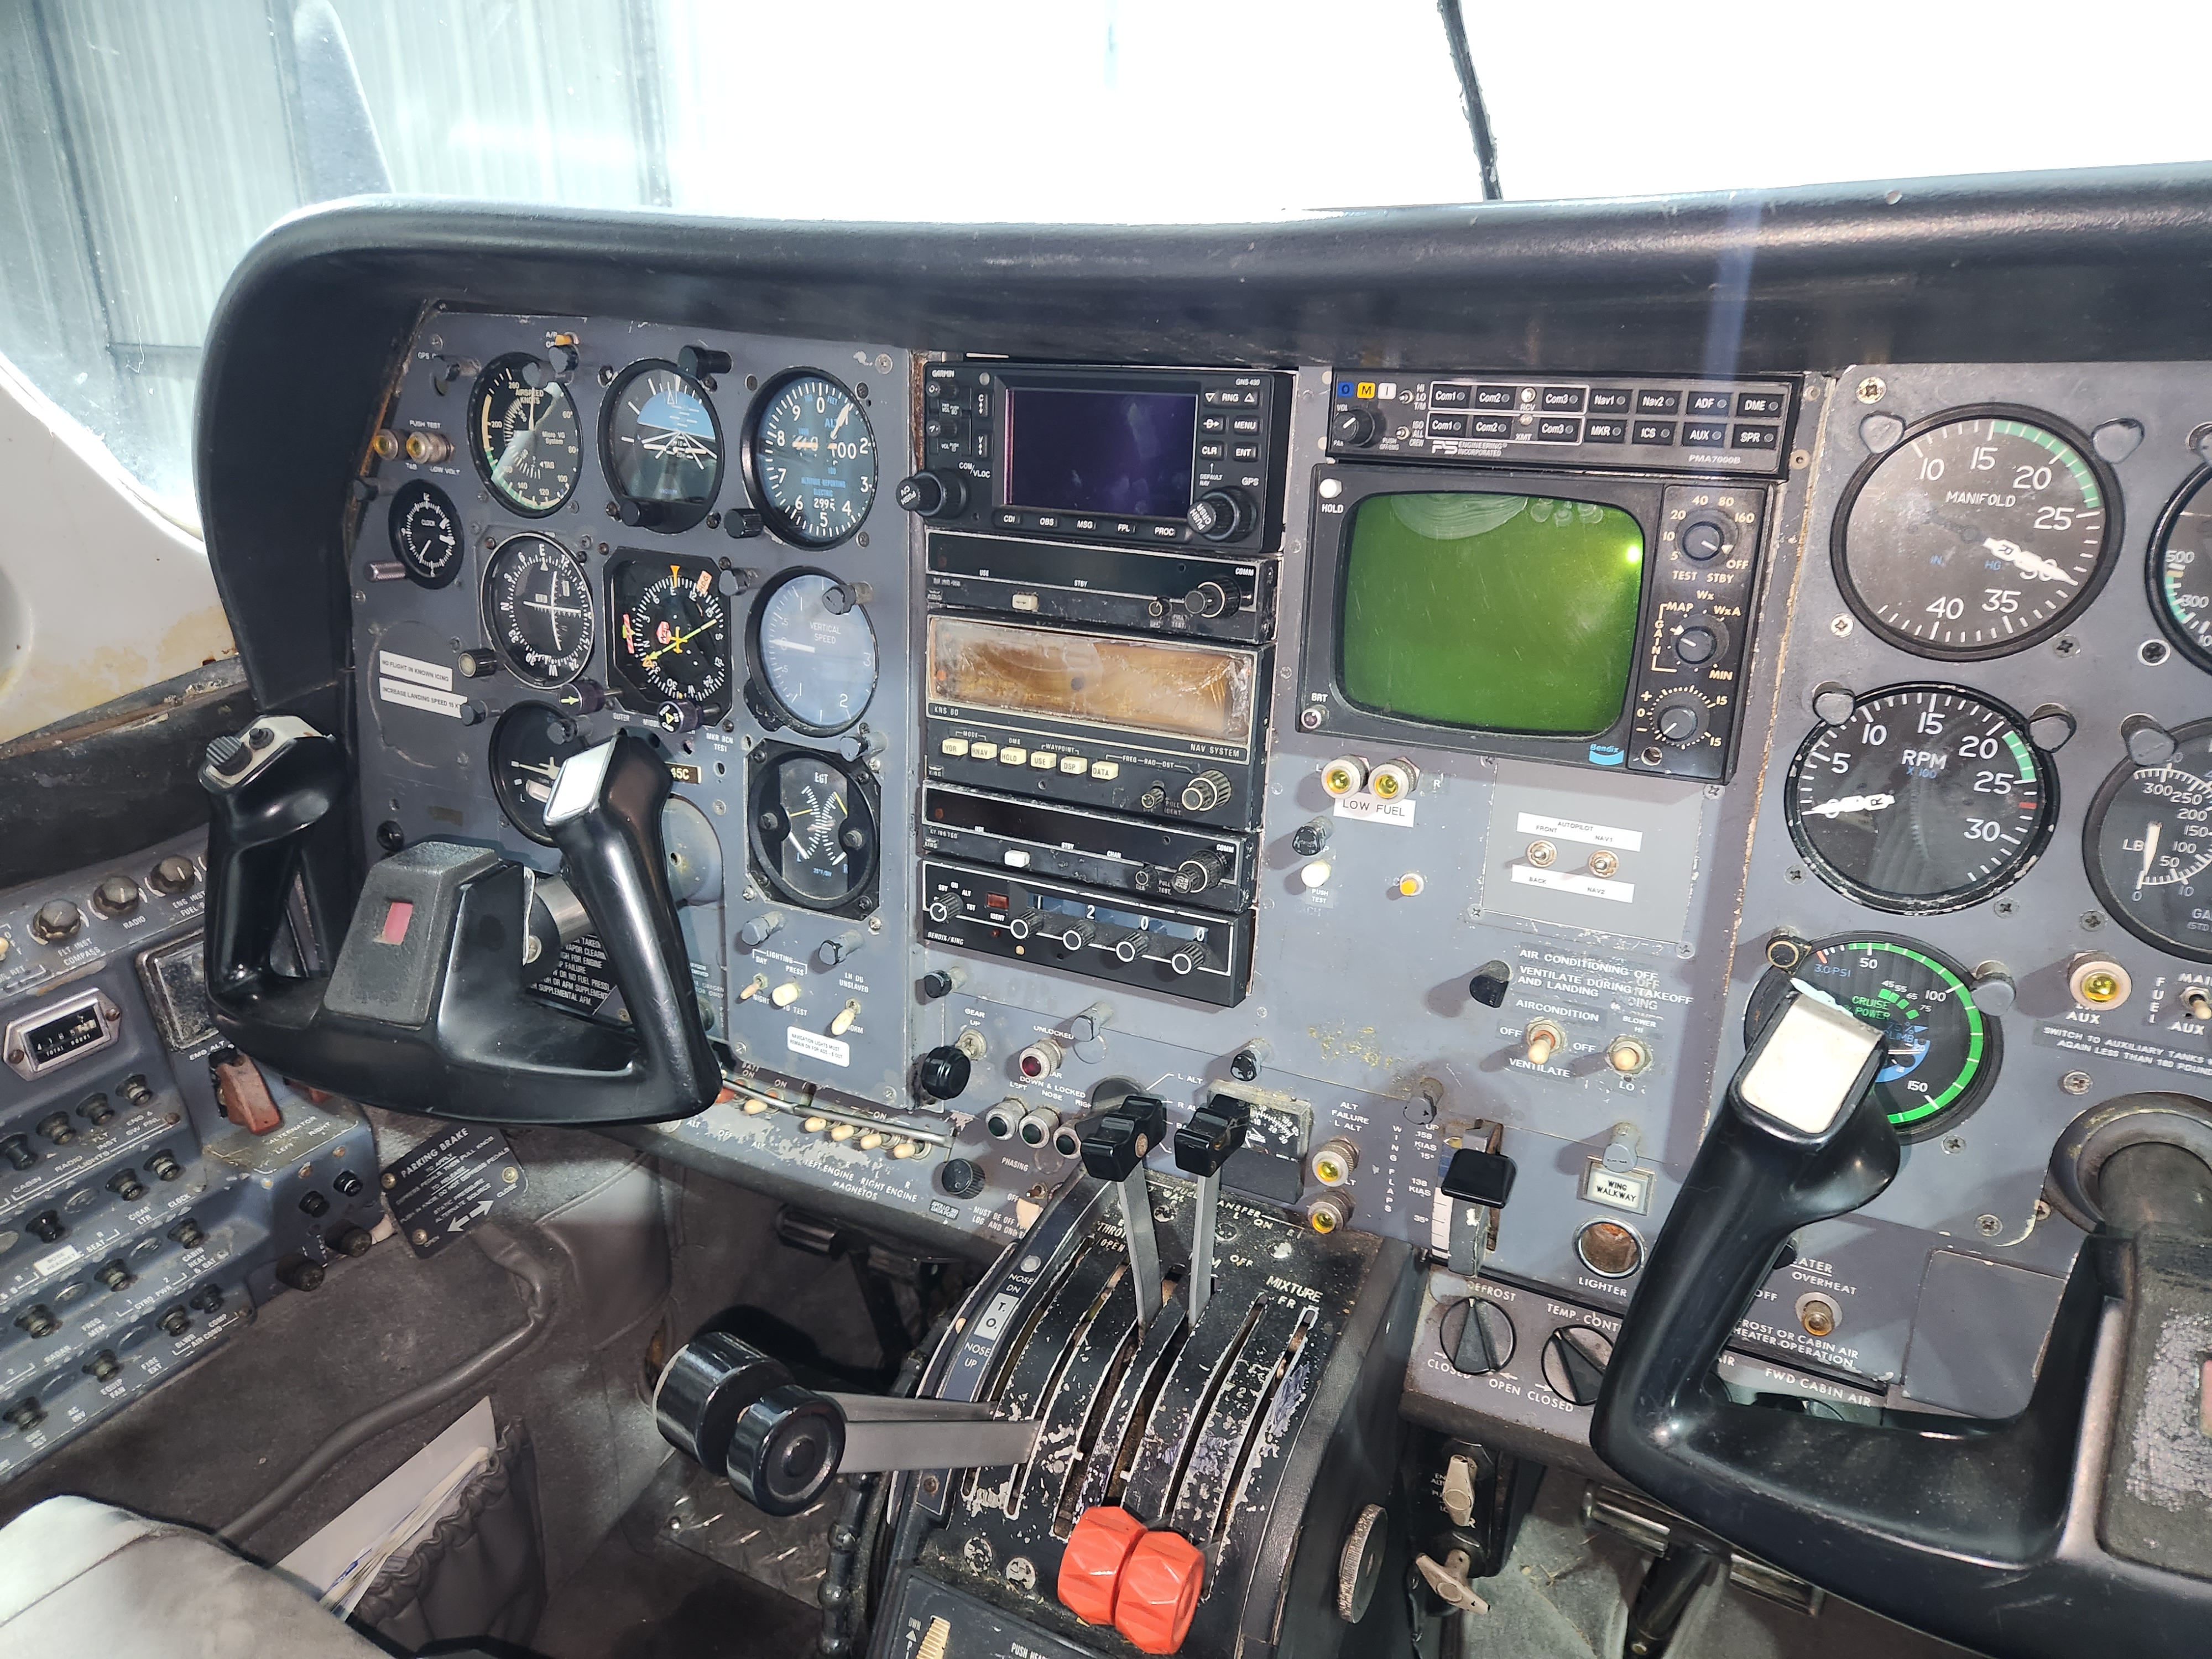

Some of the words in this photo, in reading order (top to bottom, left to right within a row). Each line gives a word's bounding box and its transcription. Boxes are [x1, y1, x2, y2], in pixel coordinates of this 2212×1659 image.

[1435, 390, 1457, 401] Com1
[1479, 392, 1500, 403] Com2
[1546, 393, 1568, 404] Com3
[1594, 395, 1614, 405] Nav1
[1642, 397, 1663, 407] Nav2
[1695, 398, 1714, 408] ADF
[1745, 400, 1765, 411] DME
[1235, 421, 1255, 430] MENU
[1432, 420, 1453, 431] Com1
[1477, 422, 1497, 432] Com2
[1542, 424, 1564, 434] Com3
[1641, 428, 1656, 438] ICS
[1690, 430, 1709, 440] AUX
[1740, 432, 1760, 442] SPR
[1202, 447, 1217, 455] CLR
[1970, 446, 1998, 471] 15
[1919, 458, 1945, 481] 10
[1241, 477, 1259, 486] GPS
[2012, 465, 2052, 490] 20
[1692, 495, 1709, 505] 40
[1718, 497, 1734, 507] 80
[1945, 491, 2016, 508] MANIFOLD
[1322, 503, 1344, 513] HOLD
[1670, 510, 1686, 520] 20
[1734, 513, 1755, 523] 160
[2033, 507, 2074, 531] 25
[1077, 520, 1093, 529] MSG
[1155, 527, 1174, 536] PROC
[1662, 531, 1676, 541] 10
[2166, 550, 2194, 564] 500
[1726, 560, 1749, 570] OFF
[1235, 567, 1254, 577] COMM
[1673, 571, 1698, 581] TEST
[1707, 572, 1734, 584] STBY
[1981, 588, 2021, 613] 35
[1666, 602, 1694, 612] MAP
[1926, 597, 1964, 620] 40
[810, 622, 841, 634] VERTICAL
[814, 633, 836, 644] SPEED
[392, 661, 408, 671] FLIGHT
[414, 668, 432, 677] KNOWN
[434, 673, 449, 682] ICING
[1709, 670, 1733, 680] MIN
[382, 686, 405, 697] INCREASE
[406, 691, 430, 703] LANDING
[431, 697, 448, 707] SPEED
[1311, 692, 1328, 702] BRT
[1917, 712, 1945, 735] 15
[1862, 723, 1887, 745] 10
[972, 748, 988, 756] RNAV
[1190, 744, 1206, 753] NAV
[1209, 747, 1239, 758] SYSTEM
[1589, 744, 1619, 753] Bendix
[1958, 735, 1999, 759] 20
[1902, 749, 1947, 770] RPM
[814, 771, 828, 784] EGT
[1093, 768, 1109, 776] DATA
[1973, 771, 2015, 794] 25
[2142, 783, 2173, 796] 300
[2171, 791, 2203, 805] 250
[1343, 800, 1370, 811] LOW
[1376, 804, 1406, 817] FUEL
[2178, 808, 2208, 821] 200
[1558, 821, 1593, 831] AUTOPILOT
[1963, 818, 2001, 842] 30
[2184, 825, 2209, 837] 150
[1217, 843, 1234, 853] COMM
[2173, 841, 2197, 853] 100
[2159, 856, 2179, 868] 50
[1528, 876, 1547, 884] BACK
[122, 916, 146, 929] RADIO
[64, 946, 101, 966] COMPASS
[766, 950, 794, 964] LIGHTING
[565, 962, 586, 974] FAILURE
[1519, 950, 1538, 960] AIR
[1544, 953, 1629, 976] CONDITIONING
[1634, 969, 1658, 980] OFF
[1859, 957, 1877, 969] 50
[785, 965, 804, 976] PRESS
[839, 979, 869, 993] UNSLAVED
[1517, 975, 1542, 987] AND
[1547, 979, 1599, 997] LANDING
[1520, 965, 1582, 984] VENTILATE
[1587, 978, 1632, 994] DURING
[1635, 987, 1693, 1006] TAKEOFF
[753, 994, 770, 1005] NIGHT
[1925, 990, 1947, 1002] 100
[1851, 995, 1890, 1010] CRUISE
[965, 1008, 985, 1019] GEAR
[1515, 999, 1599, 1022] AIRCONDITION
[1855, 1007, 1891, 1020] POWER
[1623, 1015, 1656, 1027] BLOWER
[2065, 1011, 2101, 1024] AUX
[1033, 1025, 1074, 1040] UNLOCKED
[1499, 1026, 1522, 1037] OFF
[2167, 1021, 2205, 1035] AUX
[791, 1033, 814, 1044] NAVIGATION
[815, 1041, 828, 1049] LIGHTS
[1573, 1042, 1597, 1052] OFF
[2043, 1027, 2083, 1040] SWITCH
[2088, 1035, 2101, 1044] TO
[2105, 1039, 2164, 1055] AUXILIARY
[2168, 1051, 2204, 1063] TANKS
[1020, 1076, 1044, 1088] DOWN
[1055, 1084, 1086, 1098] LOCKED
[1619, 1081, 1635, 1092] LO
[1907, 1080, 1928, 1092] 150
[1041, 1089, 1063, 1101] NOSE
[1340, 1101, 1359, 1110] ALT
[1332, 1109, 1370, 1125] FAILURE
[1414, 1141, 1437, 1151] KIAS
[401, 1149, 438, 1177] PARKING
[439, 1128, 469, 1151] BRAKE
[1001, 1156, 1029, 1172] PHASING
[1411, 1177, 1427, 1187] 138
[1608, 1180, 1627, 1191] WING
[832, 1180, 878, 1201] MAGNETOS
[861, 1177, 885, 1192] RIGHT
[886, 1185, 917, 1203] ENGINE
[1409, 1186, 1432, 1197] KIAS
[1597, 1186, 1636, 1202] WALKWAY
[168, 1193, 191, 1209] CLOCK
[86, 1240, 106, 1253] SEAT
[182, 1247, 204, 1262] CABIN
[187, 1255, 206, 1268] HEAT
[1008, 1274, 1035, 1285] NOSE
[1578, 1276, 1627, 1295] LIGHTER
[1792, 1271, 1857, 1295] OVERHEAT
[1006, 1285, 1021, 1293] DN
[1266, 1275, 1323, 1303] MIXTURE
[1467, 1281, 1516, 1302] DEFROST
[1277, 1296, 1296, 1309] FR
[964, 1342, 992, 1357] NOSE
[1780, 1340, 1854, 1367] OPERATION
[964, 1357, 977, 1368] UP
[1489, 1379, 1521, 1396] OPEN
[1766, 1368, 1795, 1384] FWD
[1800, 1379, 1844, 1399] CABIN
[1848, 1393, 1872, 1407] AIR
[1527, 1391, 1574, 1412] CLOSED
